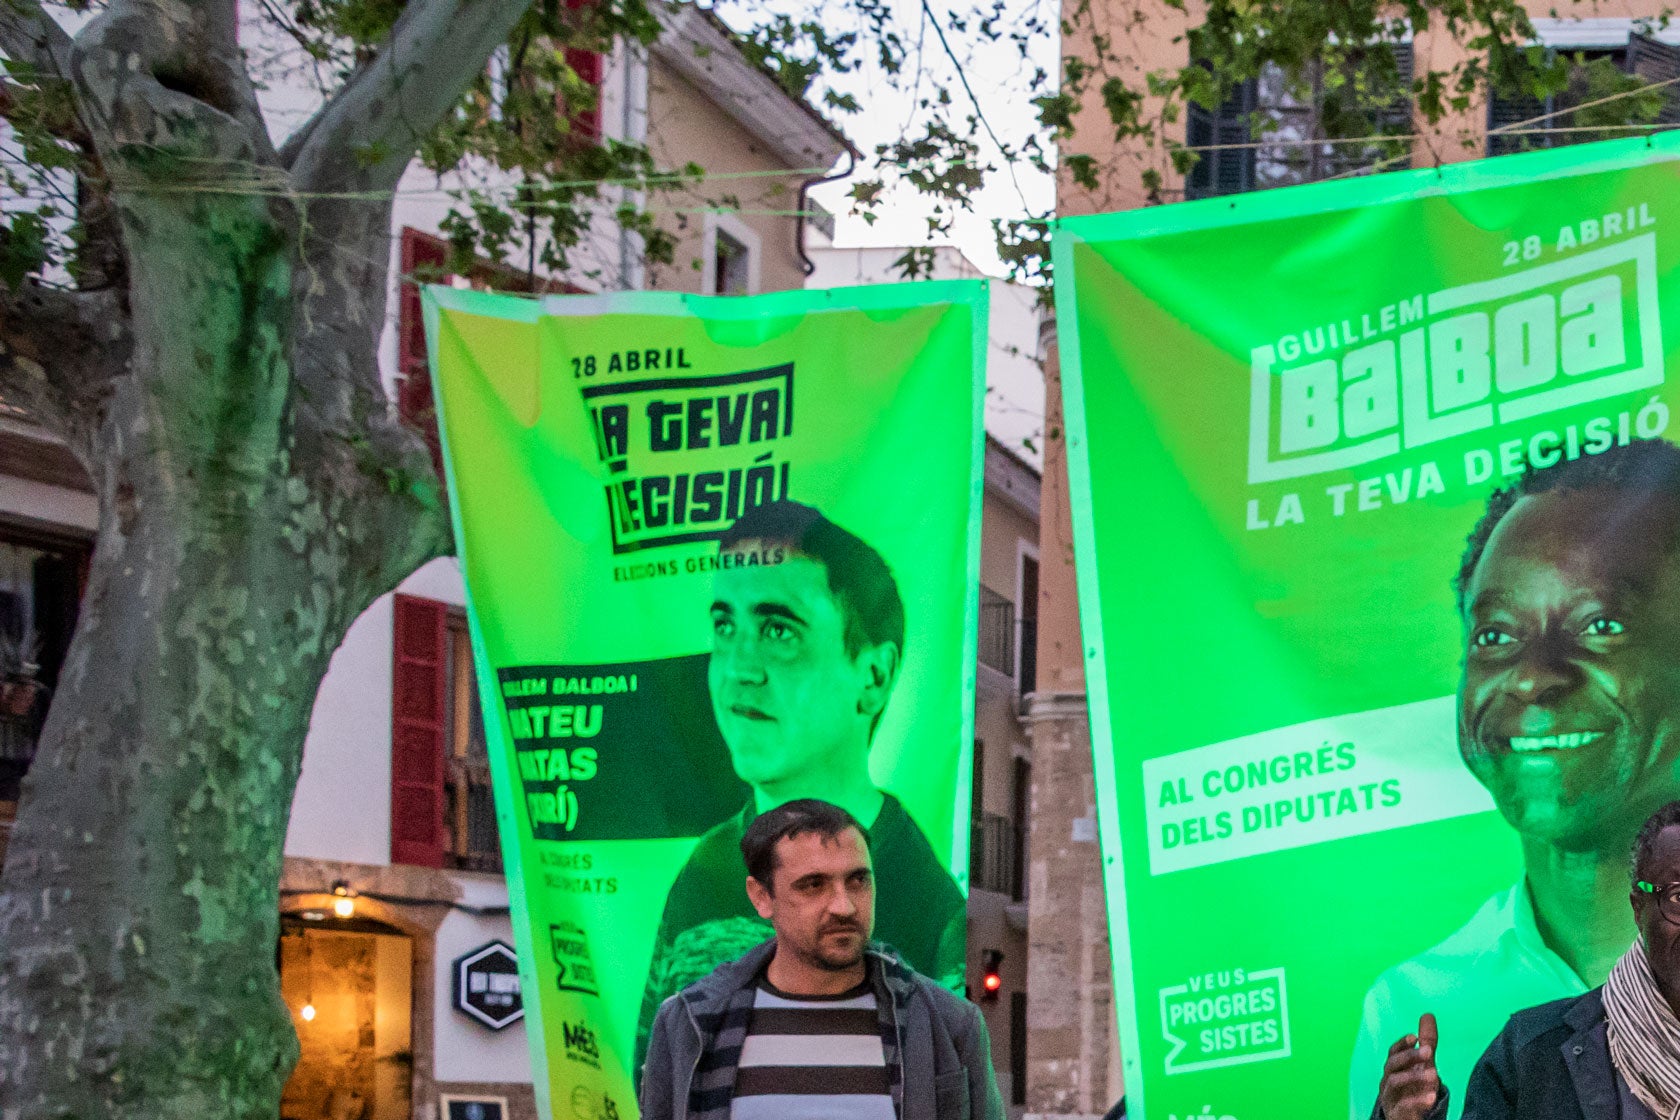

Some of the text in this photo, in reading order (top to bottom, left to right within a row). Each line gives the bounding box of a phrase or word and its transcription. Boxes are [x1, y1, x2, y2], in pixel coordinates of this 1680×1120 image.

[1502, 203, 1656, 267] 28 ABRIL
[1276, 293, 1427, 363] GUILLEM
[607, 348, 692, 374] ABRIL
[647, 388, 780, 452] TEVA
[1246, 395, 1670, 530] LA TEVA DECISIÓ
[686, 549, 784, 573] GENERALS
[1158, 740, 1357, 808] AL CONGRÉS
[1161, 779, 1402, 849] DELS DIPUTATS
[1170, 987, 1276, 1026] PROGRES
[1189, 968, 1246, 992] VEUS
[1200, 1019, 1279, 1054] SISTES
